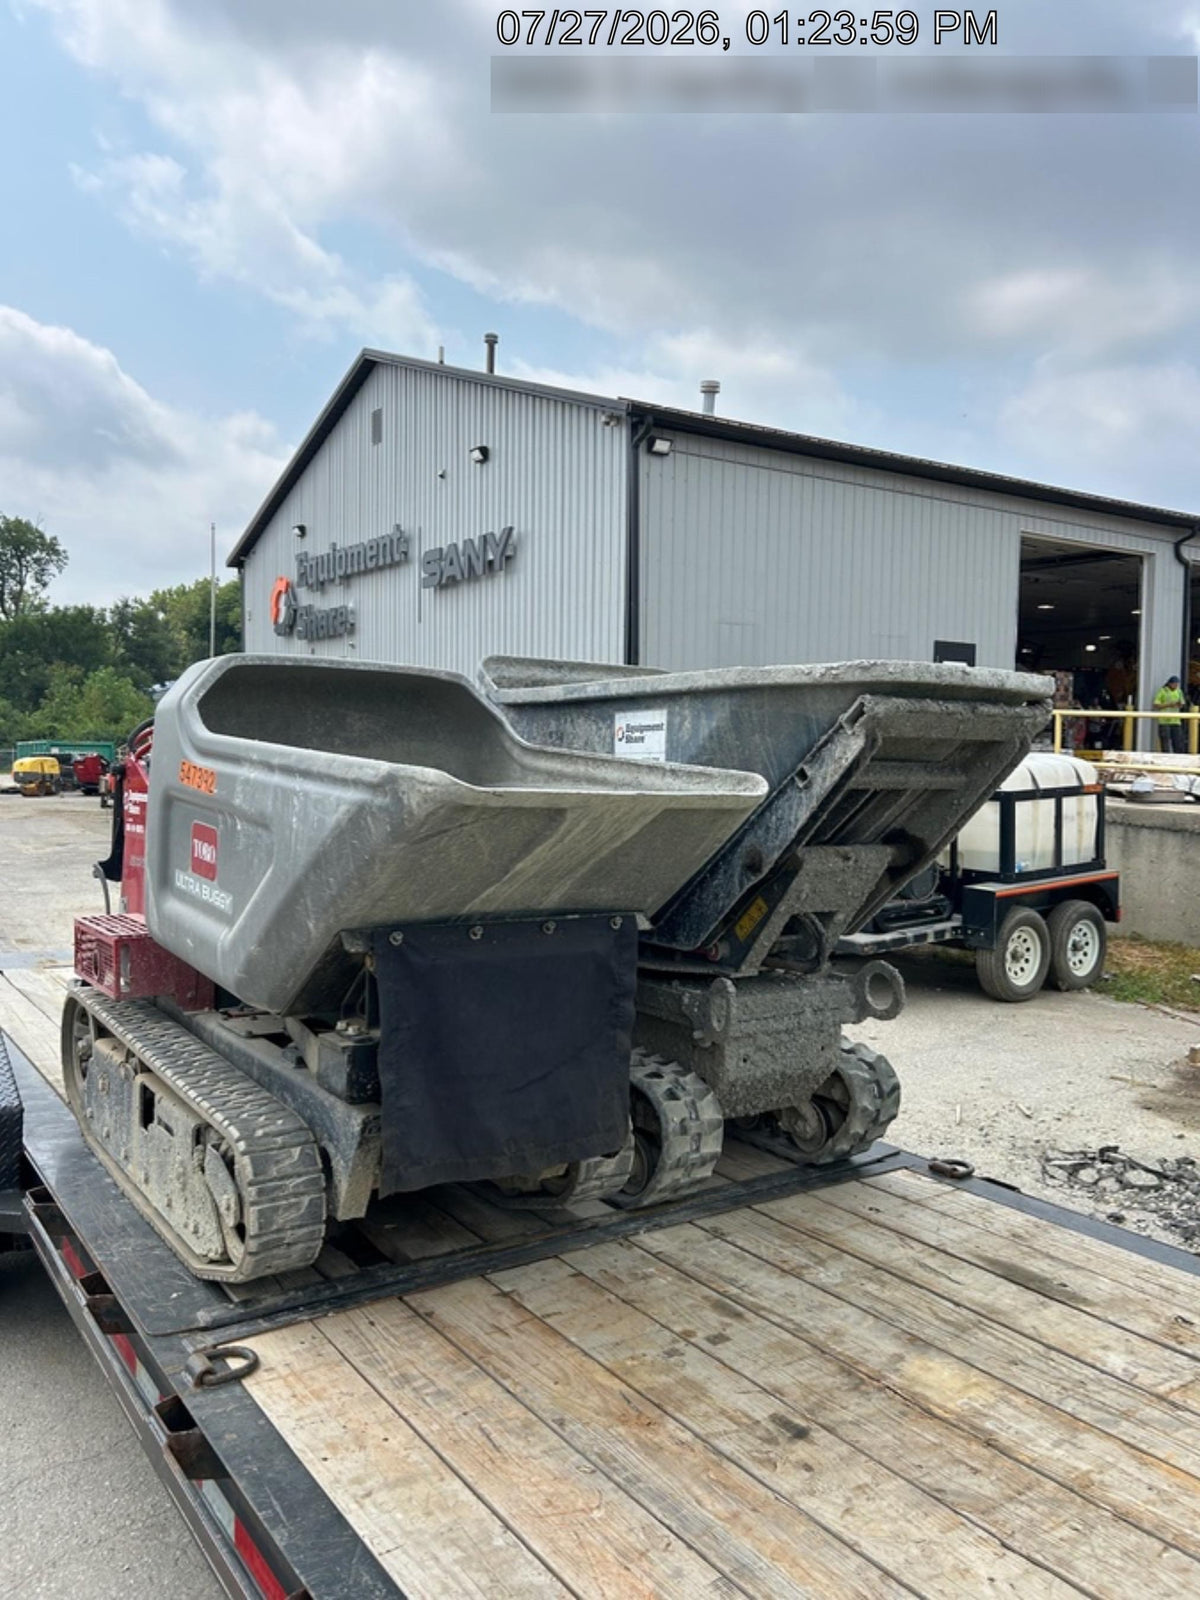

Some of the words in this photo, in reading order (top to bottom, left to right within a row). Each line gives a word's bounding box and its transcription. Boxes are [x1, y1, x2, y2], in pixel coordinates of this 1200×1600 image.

[295, 524, 408, 591] Equipment
[422, 526, 514, 589] SANY
[193, 838, 216, 863] TORO
[175, 869, 200, 896] ULTRA
